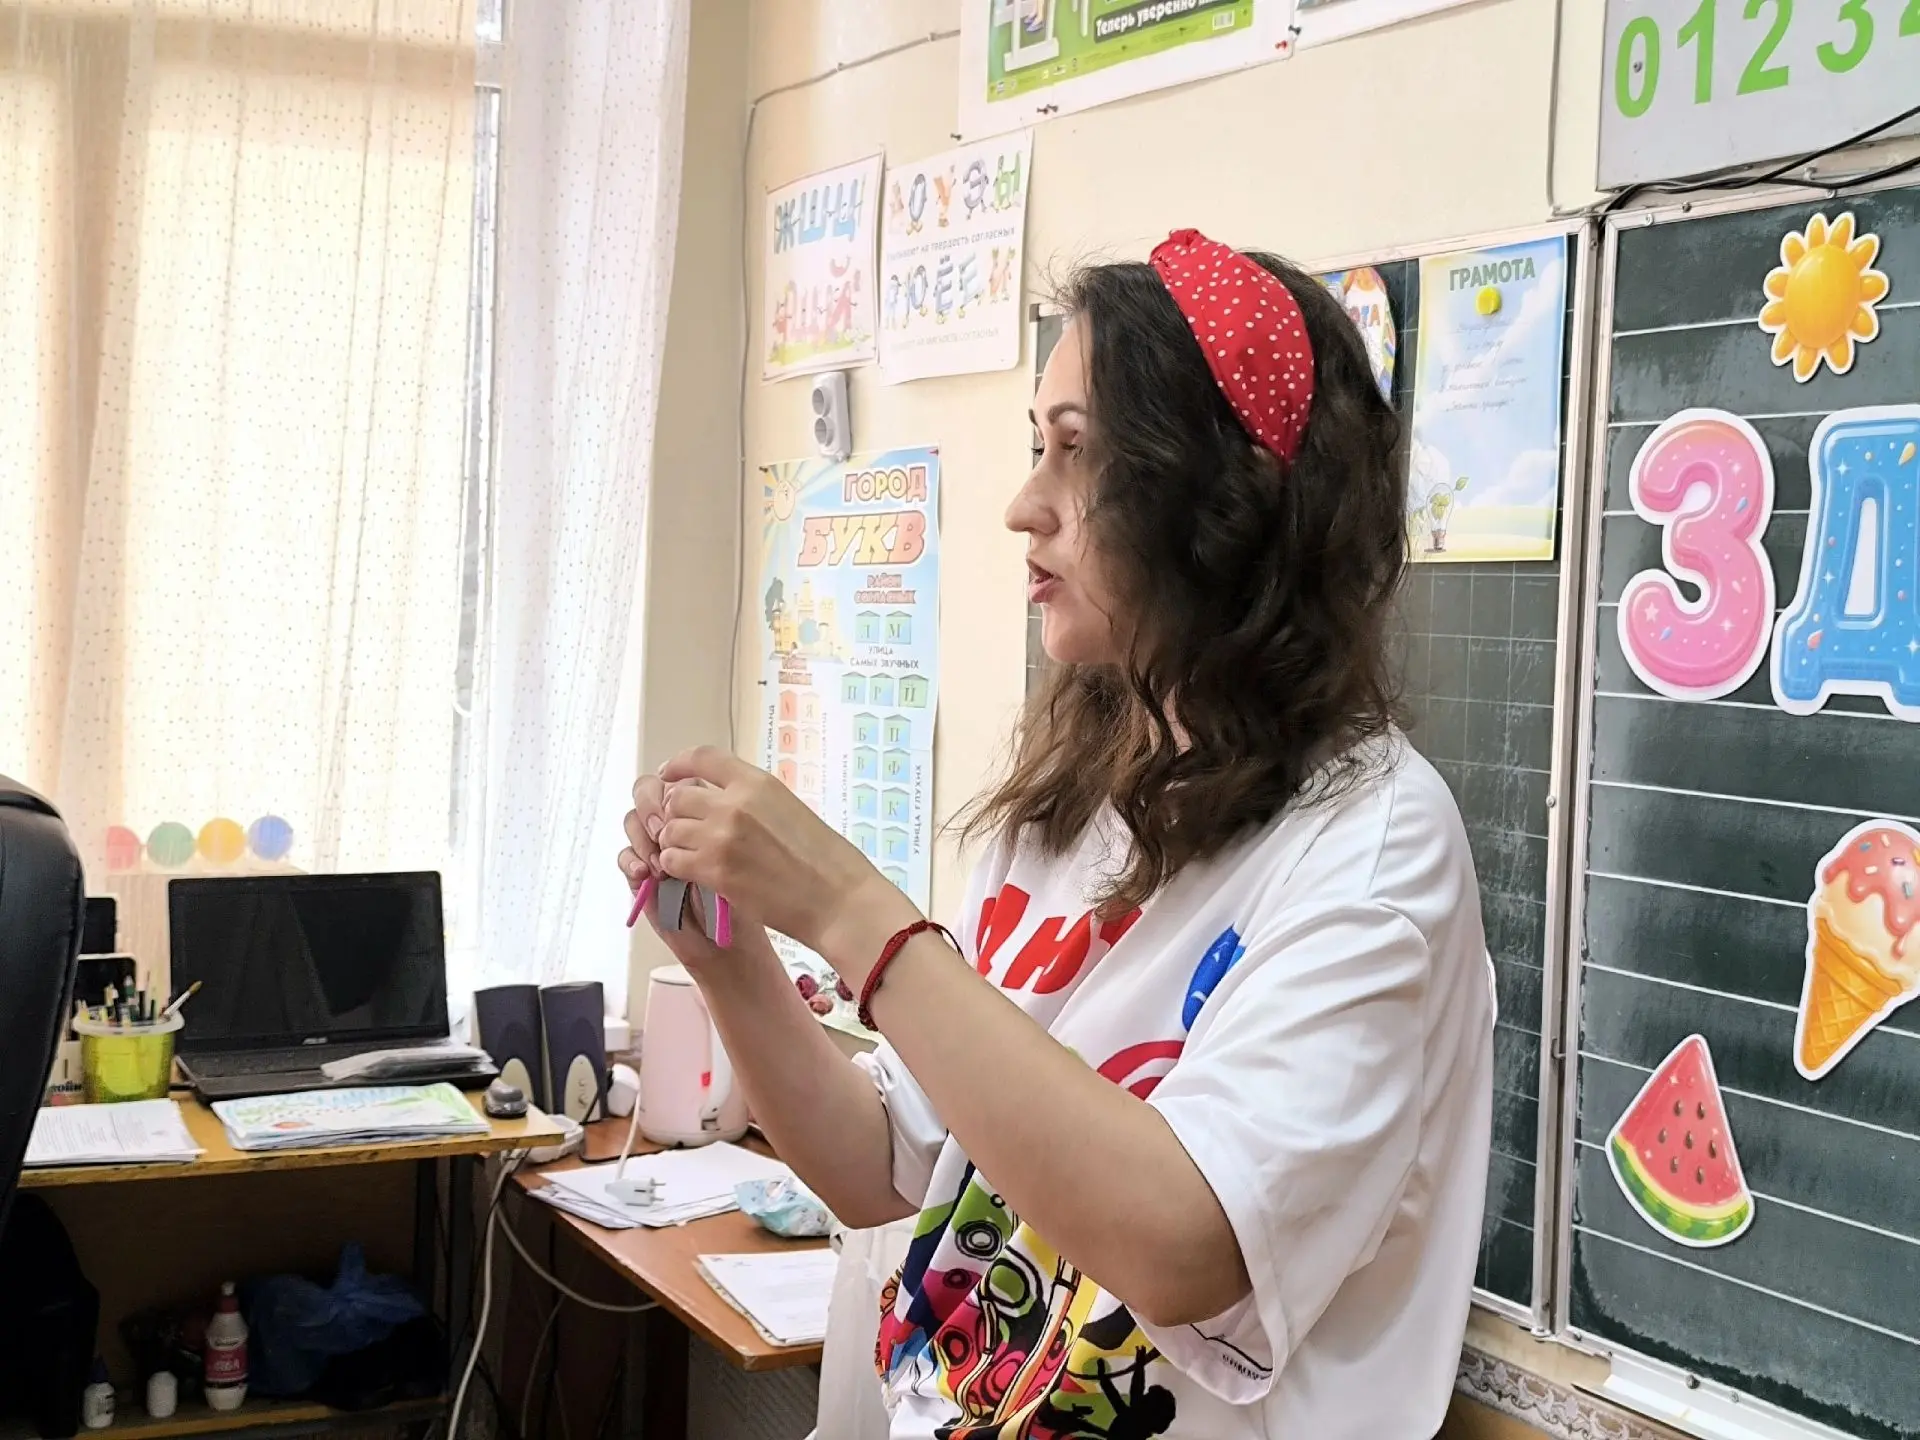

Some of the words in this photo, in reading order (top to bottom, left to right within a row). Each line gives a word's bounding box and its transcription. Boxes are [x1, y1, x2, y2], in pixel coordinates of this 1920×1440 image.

[1096, 12, 1135, 37] Теперь
[1137, 0, 1195, 27] уверенно
[1449, 256, 1536, 291] ГРАМОТА
[844, 465, 928, 502] ГОРОД
[798, 509, 927, 567] БУКВ
